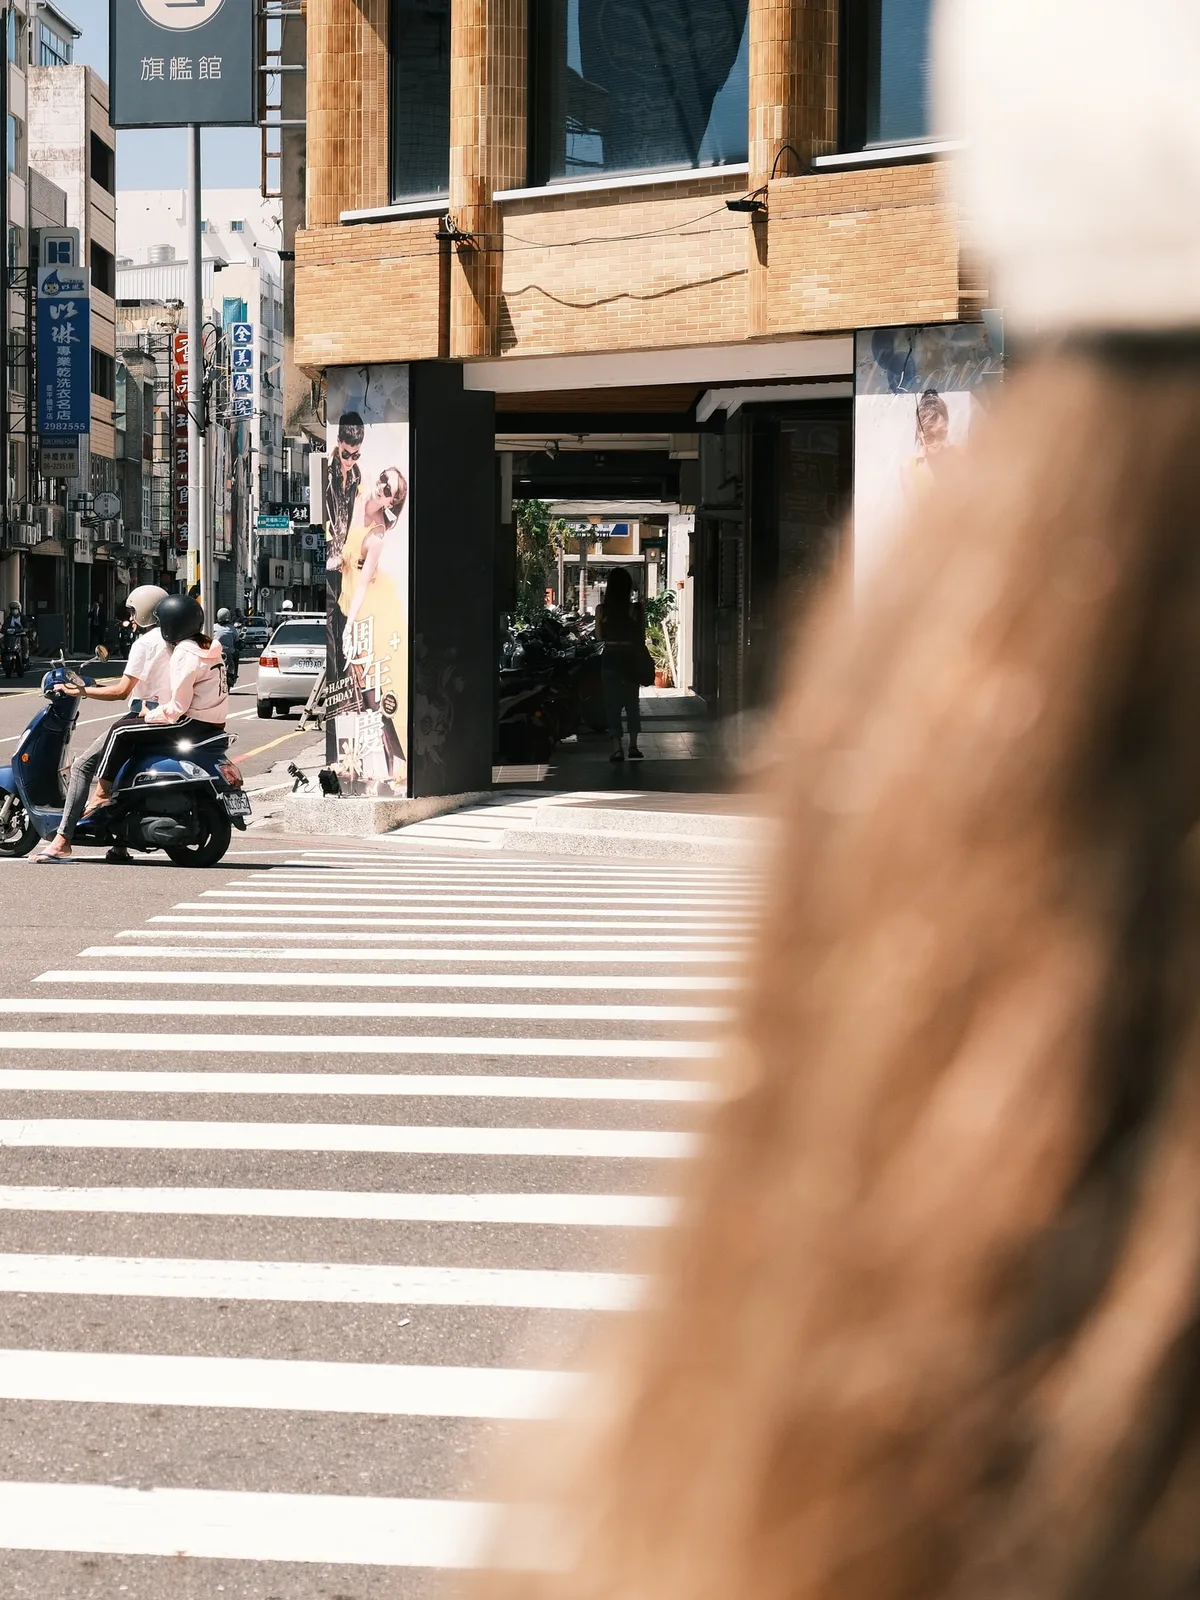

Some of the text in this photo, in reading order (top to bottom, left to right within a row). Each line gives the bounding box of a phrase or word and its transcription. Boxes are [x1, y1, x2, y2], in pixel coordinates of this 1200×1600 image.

[140, 55, 222, 81] 旗艦館
[43, 422, 86, 430] 2982555
